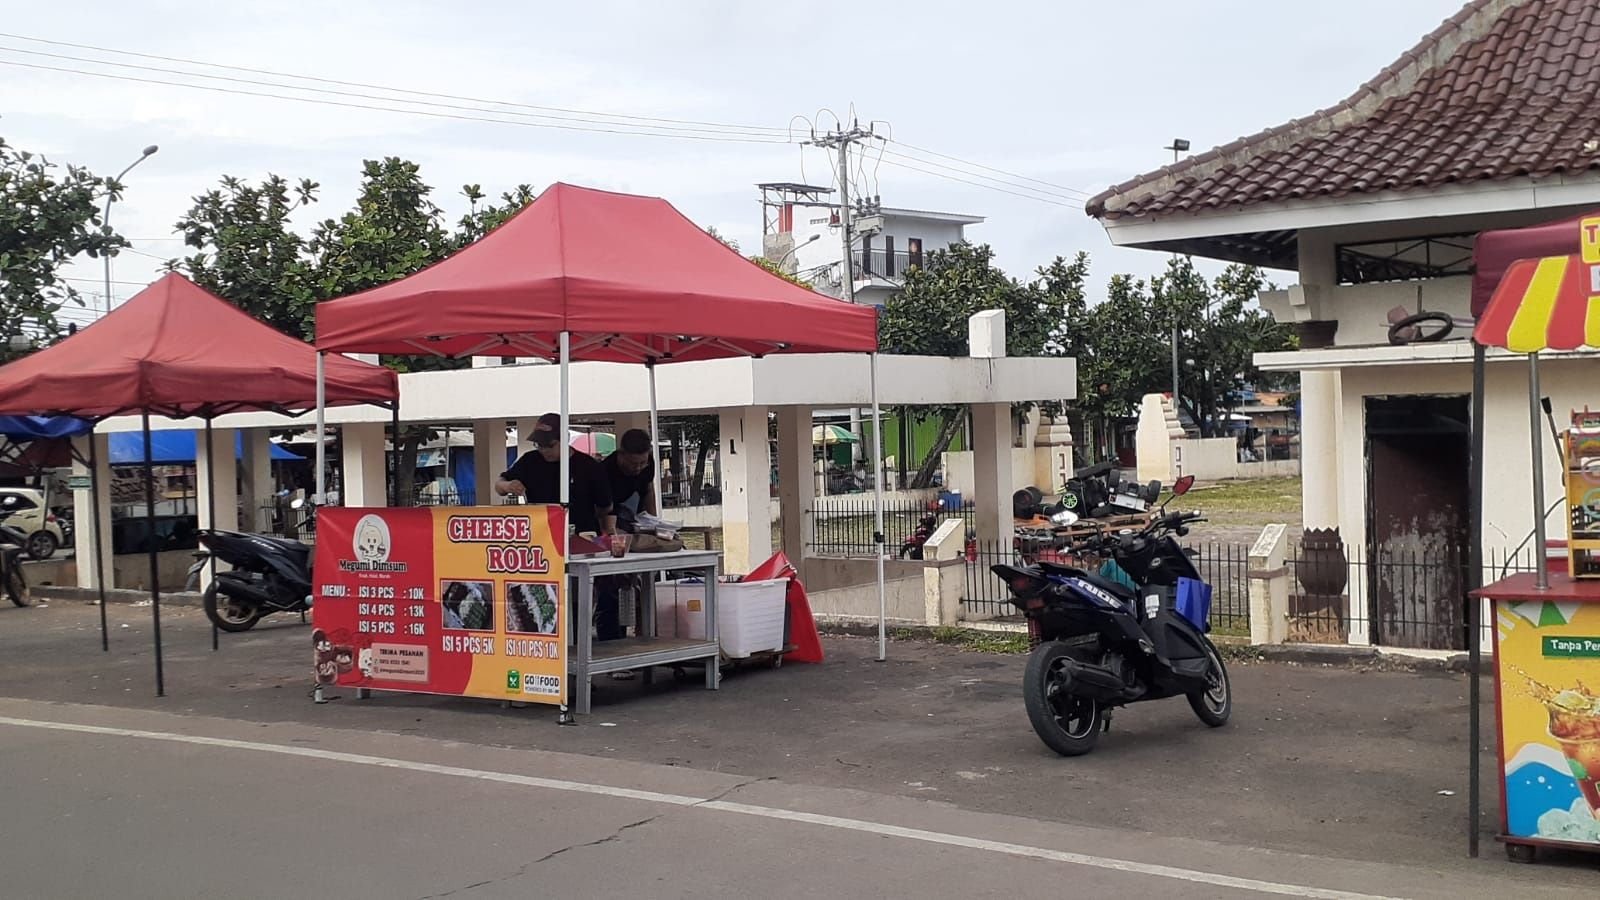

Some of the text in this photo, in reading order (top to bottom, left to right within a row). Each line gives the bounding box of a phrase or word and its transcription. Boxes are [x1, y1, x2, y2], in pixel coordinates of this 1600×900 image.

[449, 517, 529, 541] CHEESE
[339, 559, 406, 573] Megumi Dimsum
[488, 547, 548, 572] ROLL
[321, 585, 346, 597] MENU
[359, 586, 369, 598] ISI
[371, 587, 376, 598] 3
[378, 587, 394, 598] PCS
[408, 588, 424, 600] 10K
[359, 603, 369, 615] ISI
[371, 604, 377, 615] 4
[378, 604, 395, 616] PCS
[409, 605, 425, 617] 13K
[359, 621, 369, 633] ISI
[371, 622, 377, 633] 5
[378, 622, 395, 634] PCS
[442, 636, 494, 654] ISI 5 PCS 5K
[506, 640, 559, 659] ISI 10 PCS 10K
[1550, 640, 1582, 653] Tanpa
[540, 676, 559, 687] FOOD
